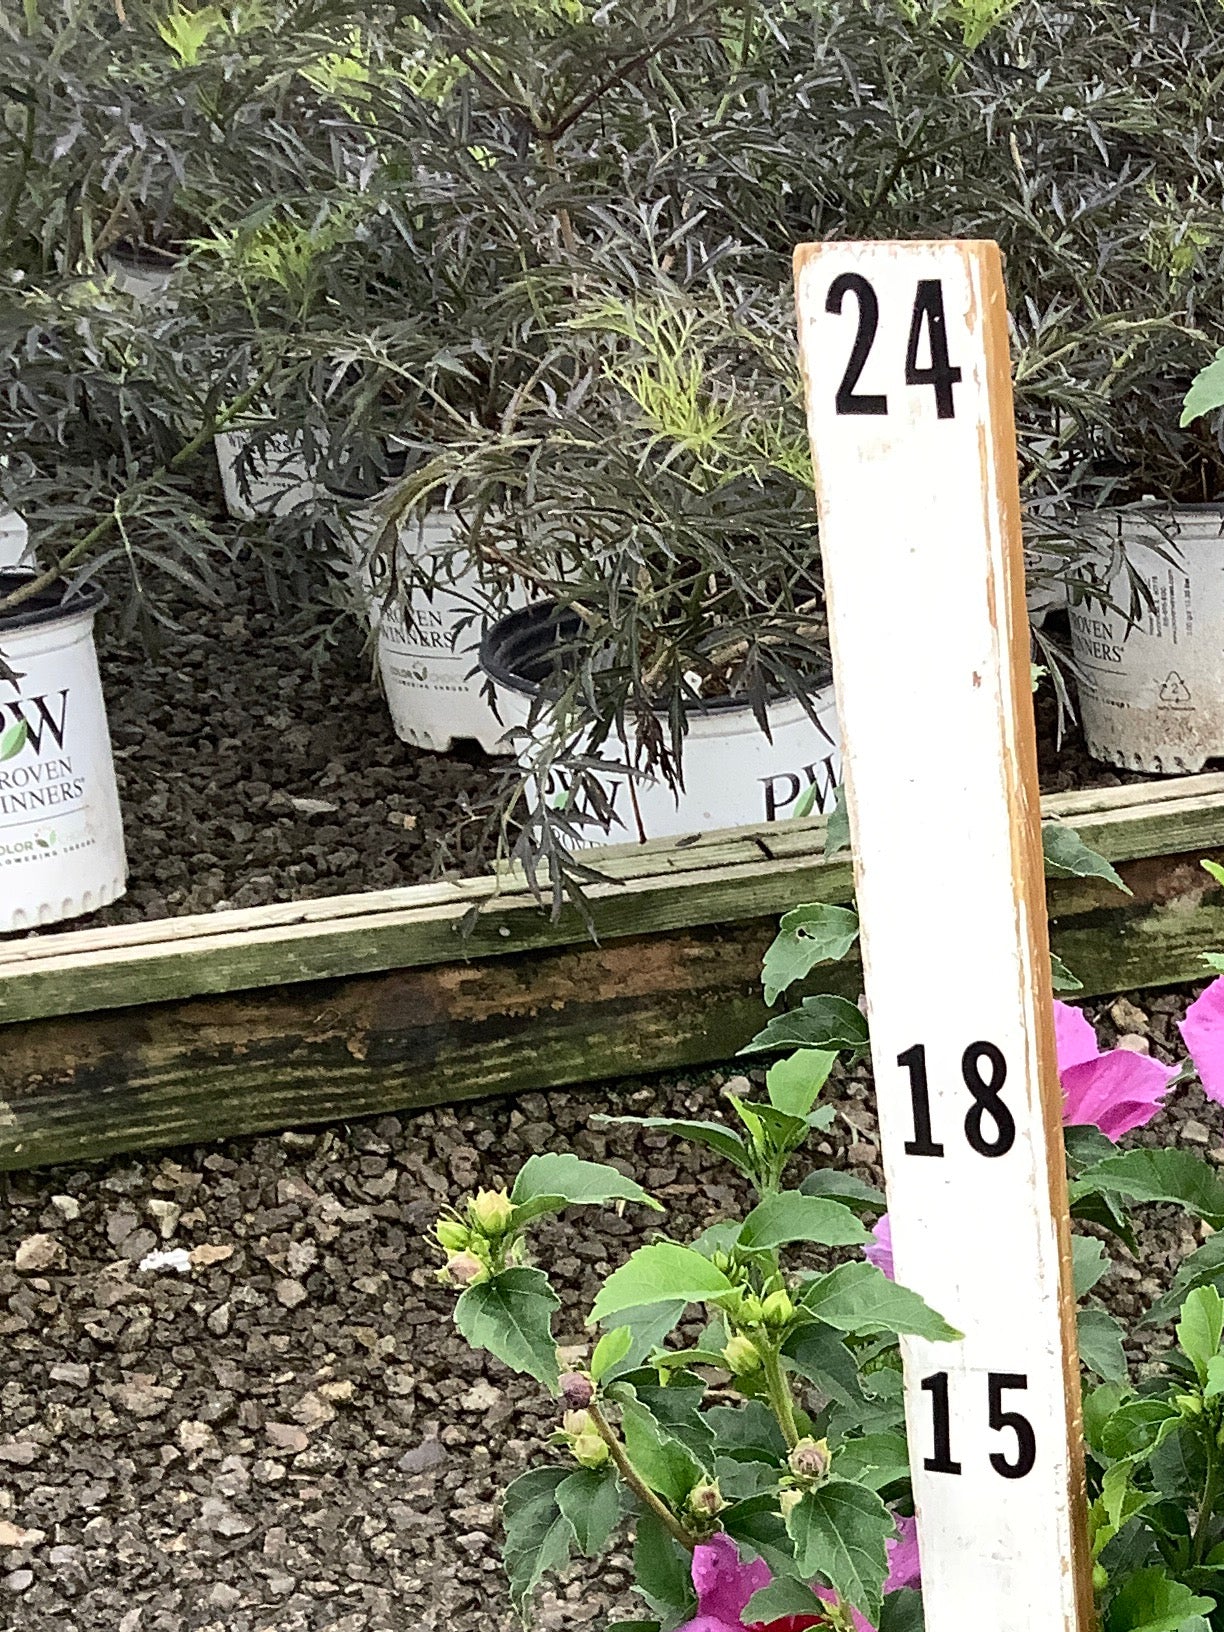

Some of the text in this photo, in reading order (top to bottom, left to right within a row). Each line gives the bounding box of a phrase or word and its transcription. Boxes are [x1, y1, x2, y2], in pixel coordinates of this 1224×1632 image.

[825, 272, 962, 419] 24
[0, 688, 69, 756] W
[0, 757, 73, 790] ROVEN
[0, 841, 33, 856] OLOR
[897, 1041, 1016, 1158] 18
[921, 1371, 1036, 1479] 15
